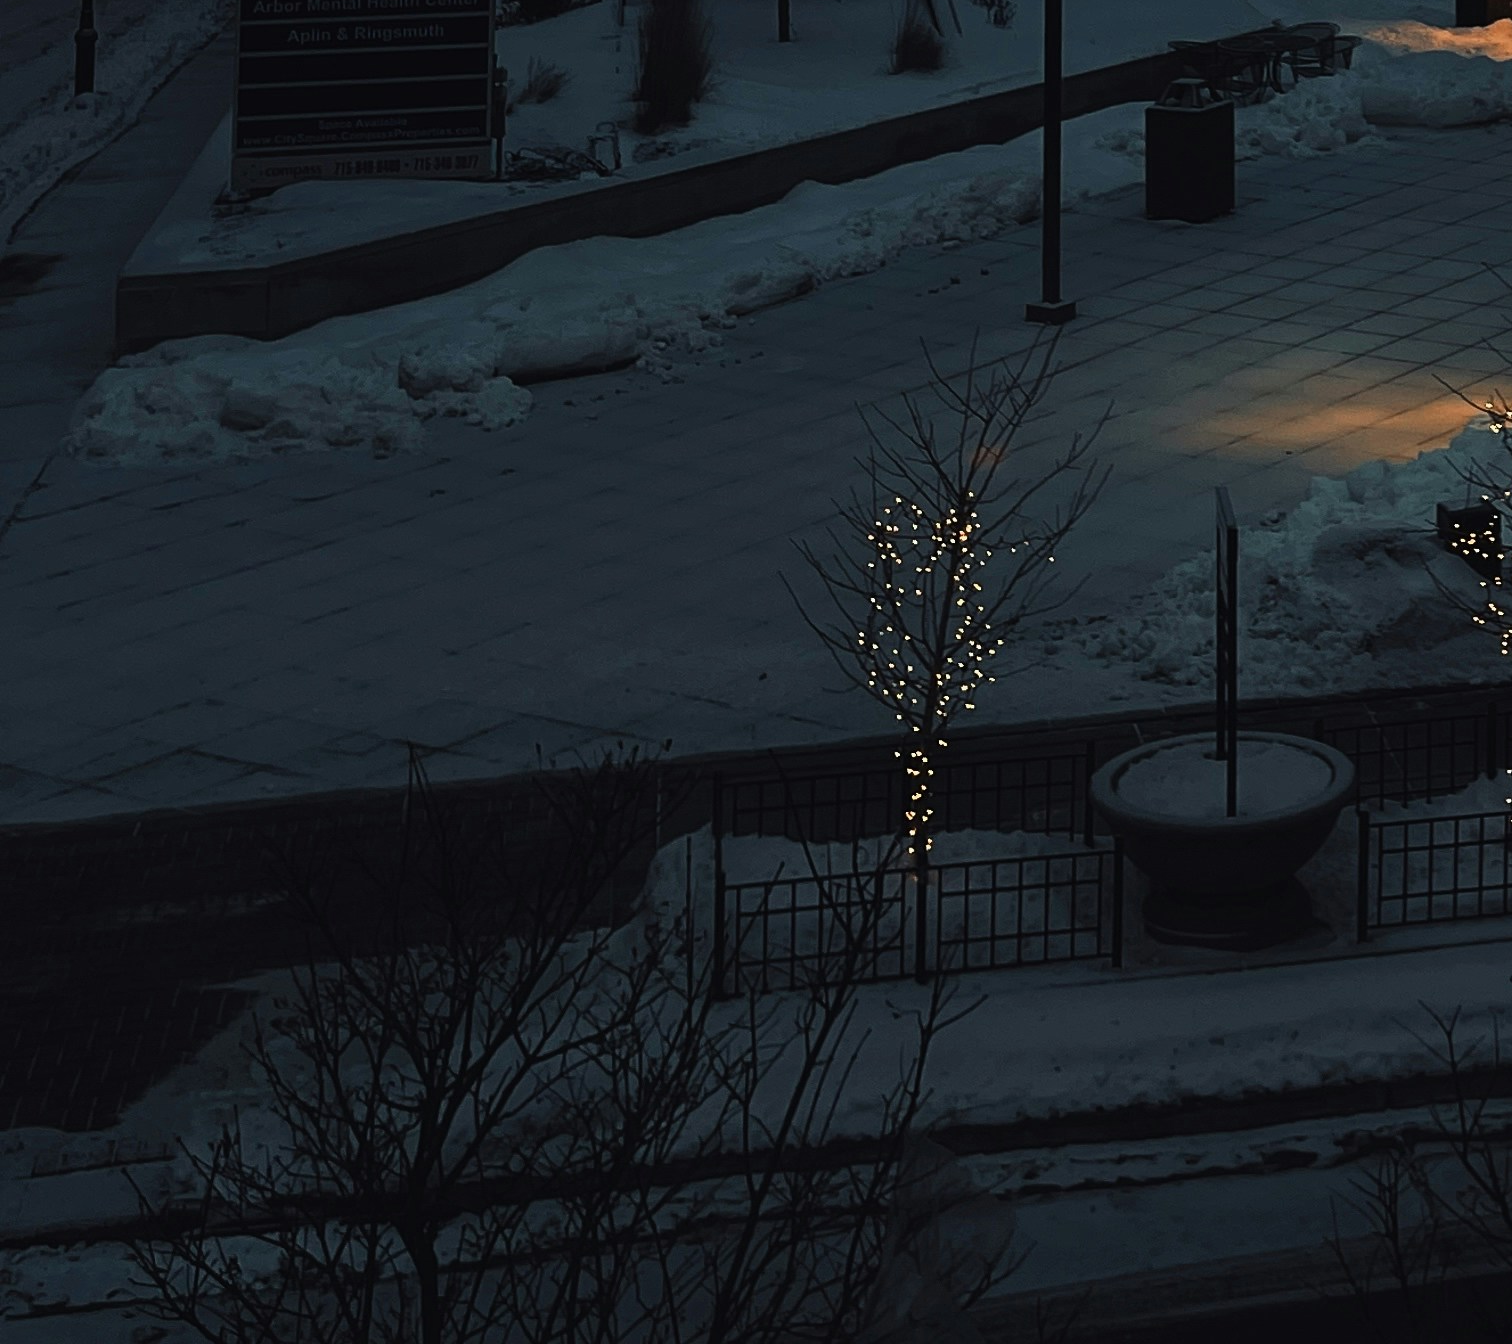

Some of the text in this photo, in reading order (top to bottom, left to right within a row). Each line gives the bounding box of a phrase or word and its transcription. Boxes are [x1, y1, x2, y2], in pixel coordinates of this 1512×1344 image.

[253, 0, 302, 14] Arbor
[287, 24, 444, 45] Aplin & Ringsmuth
[265, 165, 322, 179] compass
